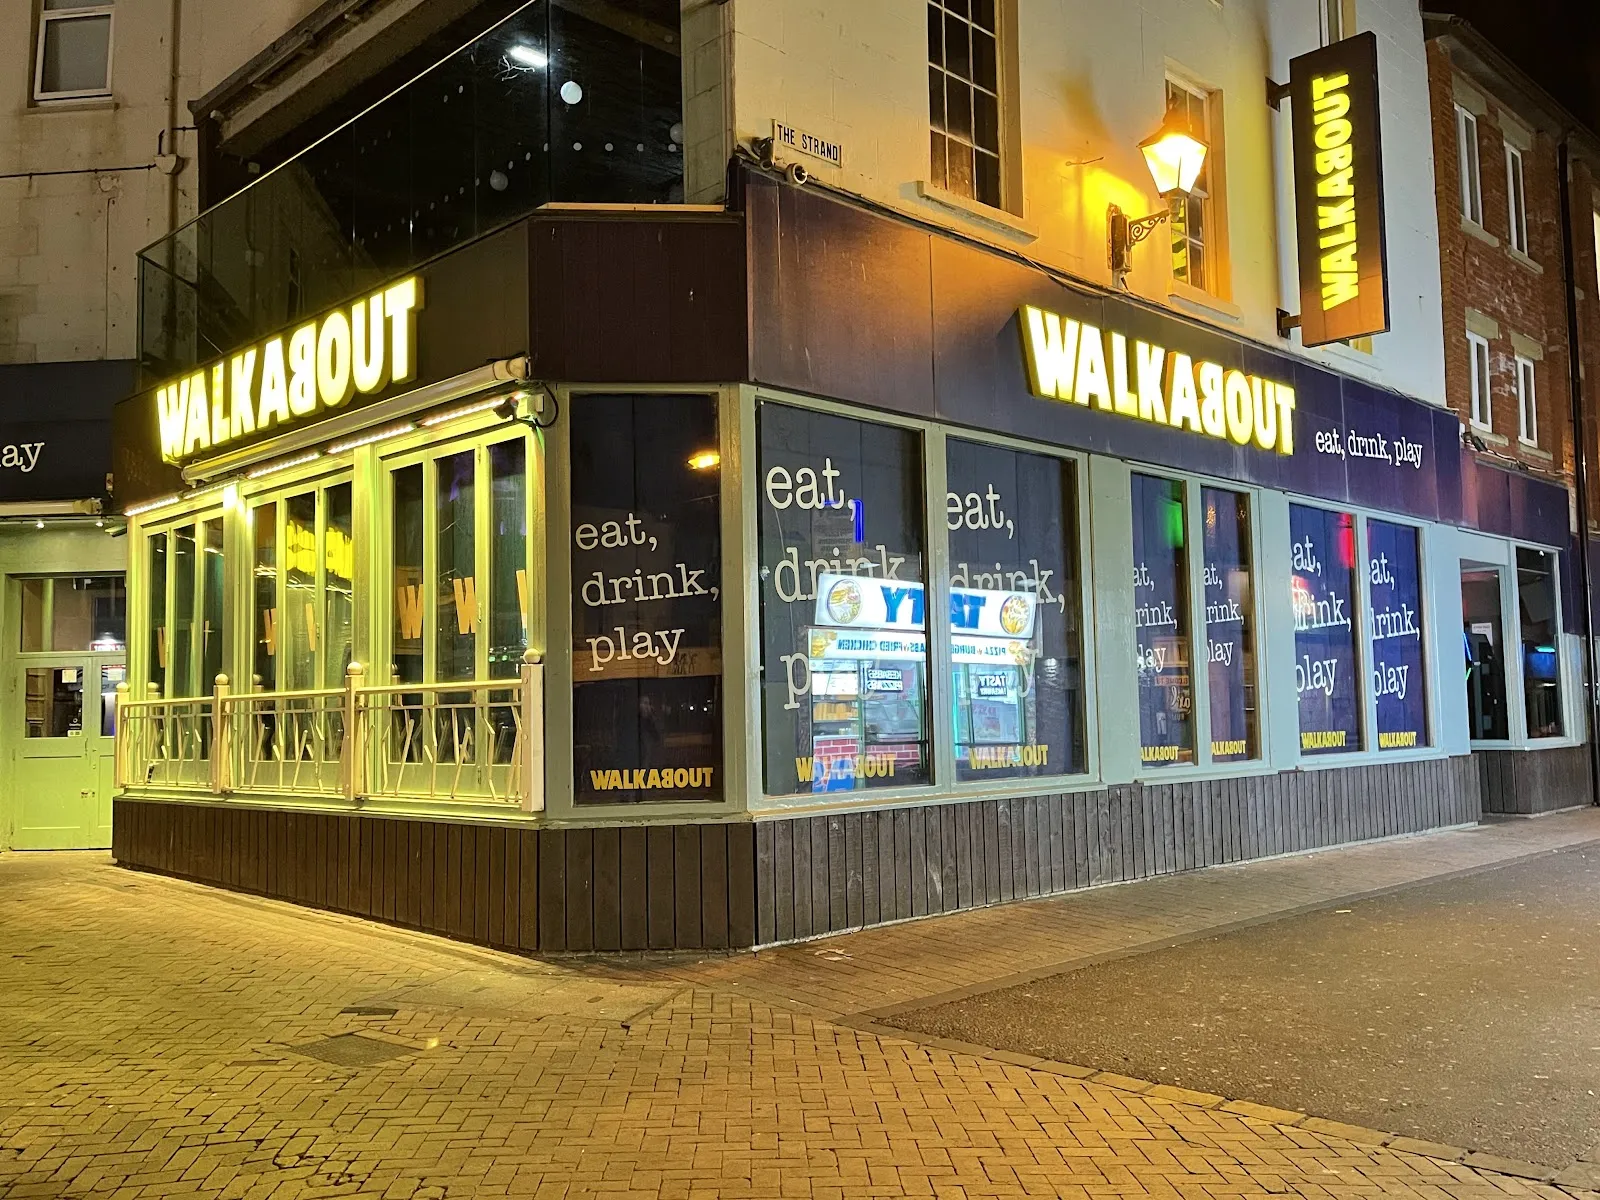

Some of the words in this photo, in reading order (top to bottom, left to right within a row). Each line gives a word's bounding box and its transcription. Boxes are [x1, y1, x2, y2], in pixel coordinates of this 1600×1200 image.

[777, 124, 796, 146] THE
[801, 134, 838, 162] STRAND
[1312, 73, 1359, 312] WALKABOUT
[156, 276, 418, 464] WALKABOUT
[1020, 303, 1297, 456] WALKABOUT
[0, 441, 45, 473] ay
[1315, 428, 1345, 461] eat,
[1347, 429, 1392, 466] drink,
[1393, 436, 1423, 469] play
[765, 457, 857, 522] eat,
[946, 483, 1015, 540] eat,
[575, 512, 658, 552] eat,
[1292, 535, 1322, 578] at,
[1369, 551, 1395, 591] at,
[581, 562, 720, 608] drink,
[1133, 561, 1155, 592] at,
[1203, 562, 1223, 590] at,
[1135, 600, 1178, 630] rink,
[1205, 598, 1245, 626] rink,
[586, 626, 686, 672] play
[1136, 643, 1167, 673] lay
[968, 744, 1049, 770] WALKABOUT
[1140, 745, 1179, 762] ALKABOUT
[1211, 739, 1247, 756] ALKABOUT
[1301, 730, 1347, 749] WALKABOUT
[1378, 731, 1417, 749] WALKABOUT
[589, 767, 714, 791] WALKABOUT
